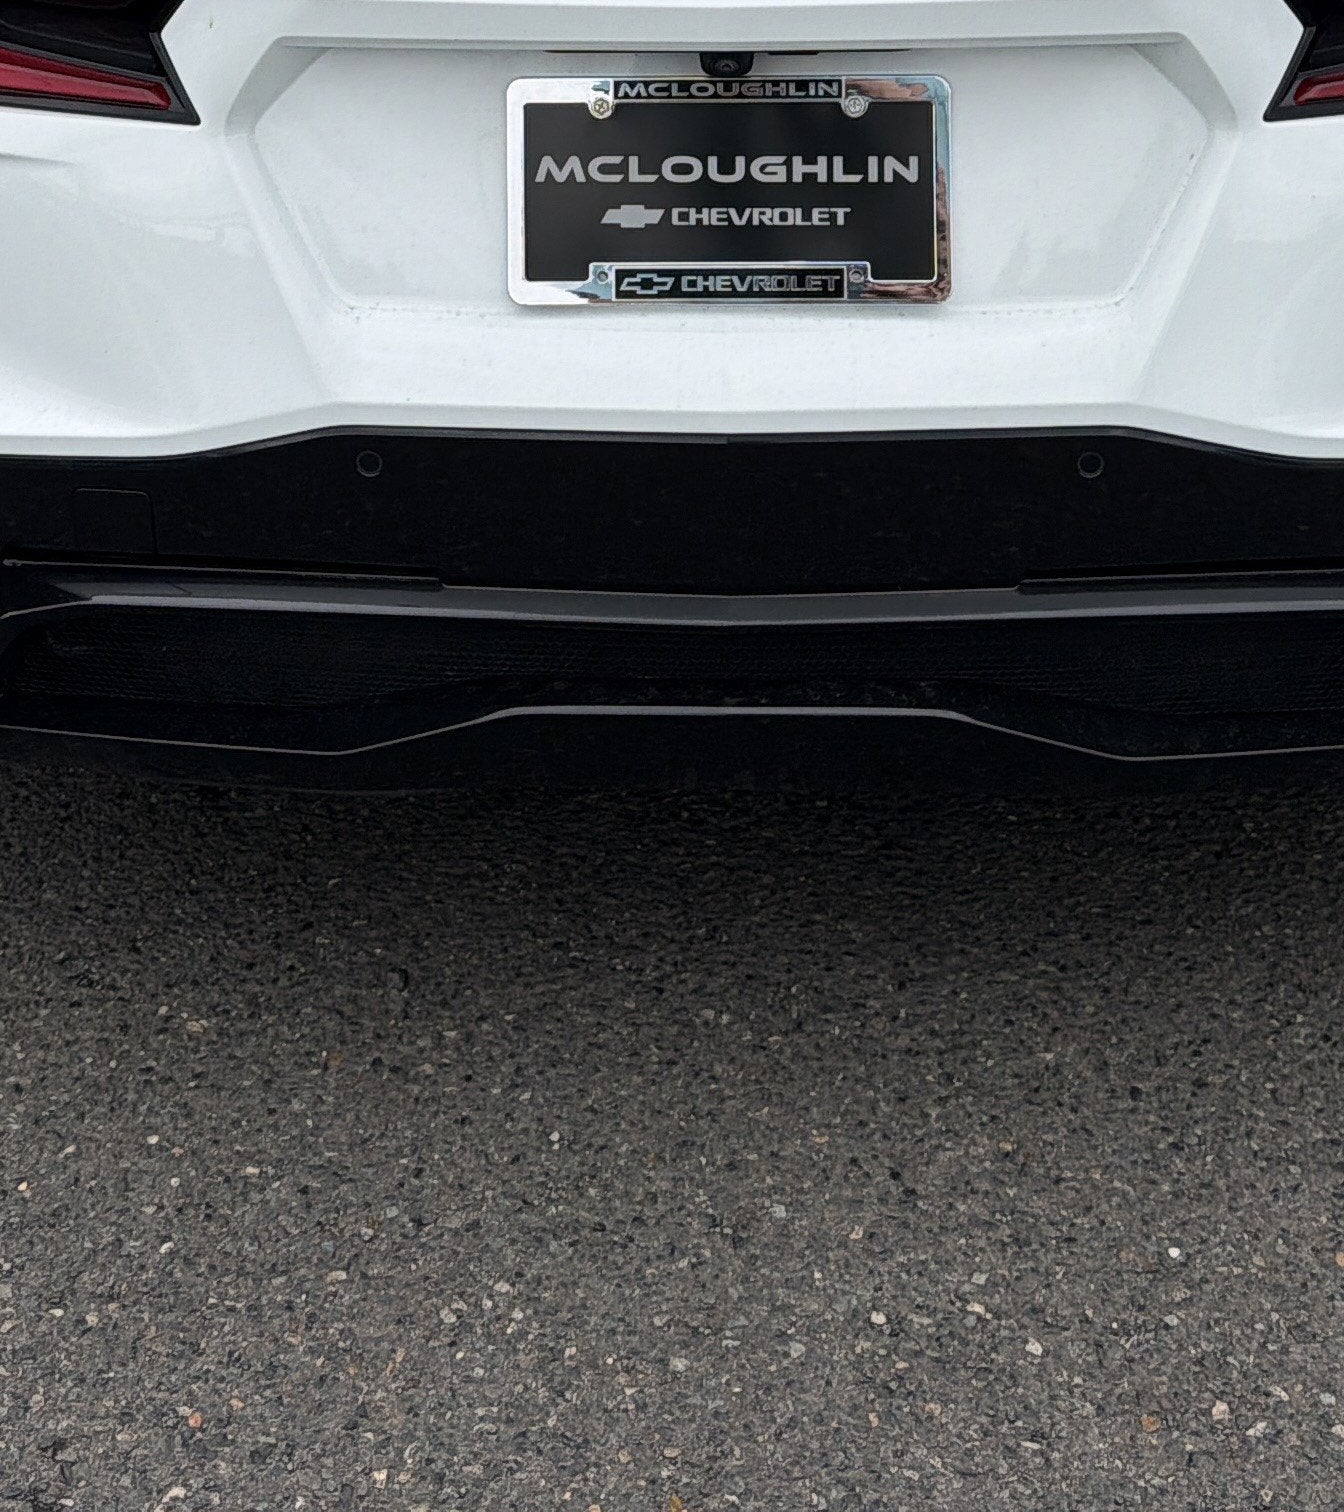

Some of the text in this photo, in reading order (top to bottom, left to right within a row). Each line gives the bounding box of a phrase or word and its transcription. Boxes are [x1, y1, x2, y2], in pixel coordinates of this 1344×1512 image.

[617, 82, 839, 98] MCLOUGHLIN
[535, 155, 919, 183] MCLOUGHLIN
[671, 207, 851, 226] CHEVROLET
[681, 275, 840, 292] CHEVROLET
